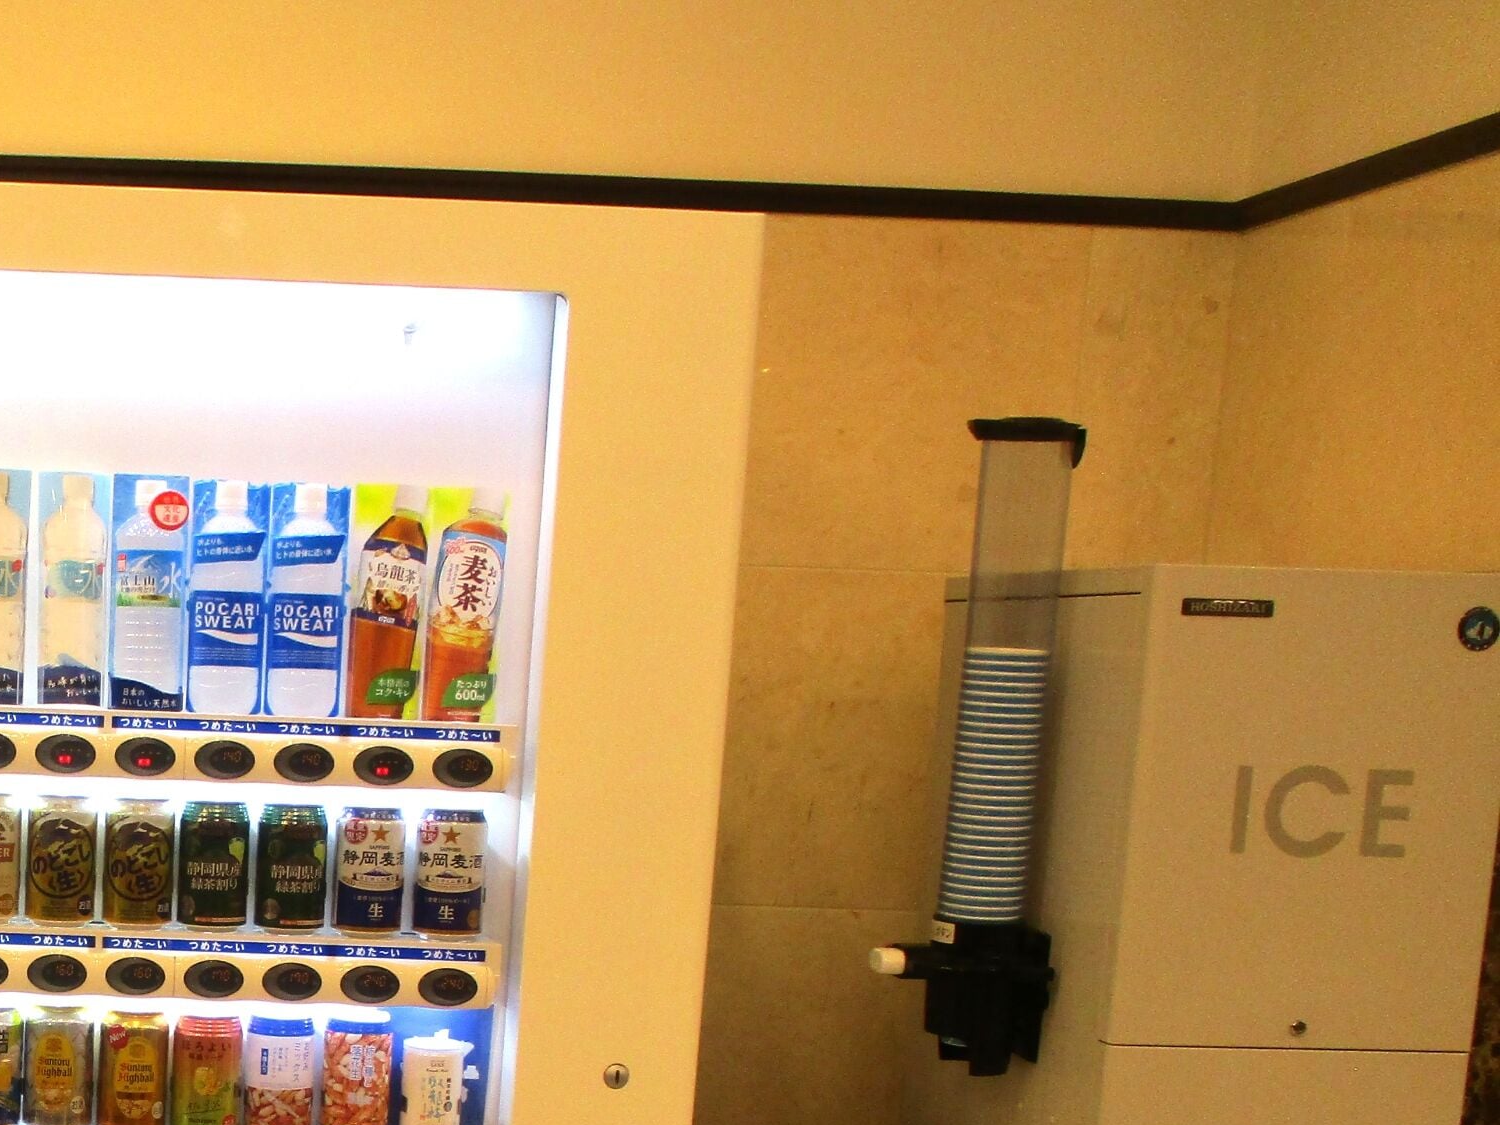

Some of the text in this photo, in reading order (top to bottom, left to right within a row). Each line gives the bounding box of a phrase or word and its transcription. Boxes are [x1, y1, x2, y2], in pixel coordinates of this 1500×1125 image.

[374, 562, 417, 584] 烏龍茶
[454, 554, 489, 613] 麦茶
[195, 601, 260, 617] POCARI
[274, 603, 339, 618] POCARI
[1190, 601, 1267, 614] HOSHIZAKI
[194, 615, 255, 629] SWEAT
[273, 617, 334, 632] SWEAT
[455, 678, 487, 690] たっぷり
[122, 687, 145, 697] 日本の
[454, 688, 486, 702] 600ml
[121, 697, 178, 709] おいしい天然水
[1229, 765, 1415, 858] ICE
[419, 852, 484, 870] 静岡麦酒
[186, 861, 242, 878] 静岡県産
[367, 903, 384, 919] 生
[437, 905, 455, 920] 生
[108, 1029, 127, 1044] New
